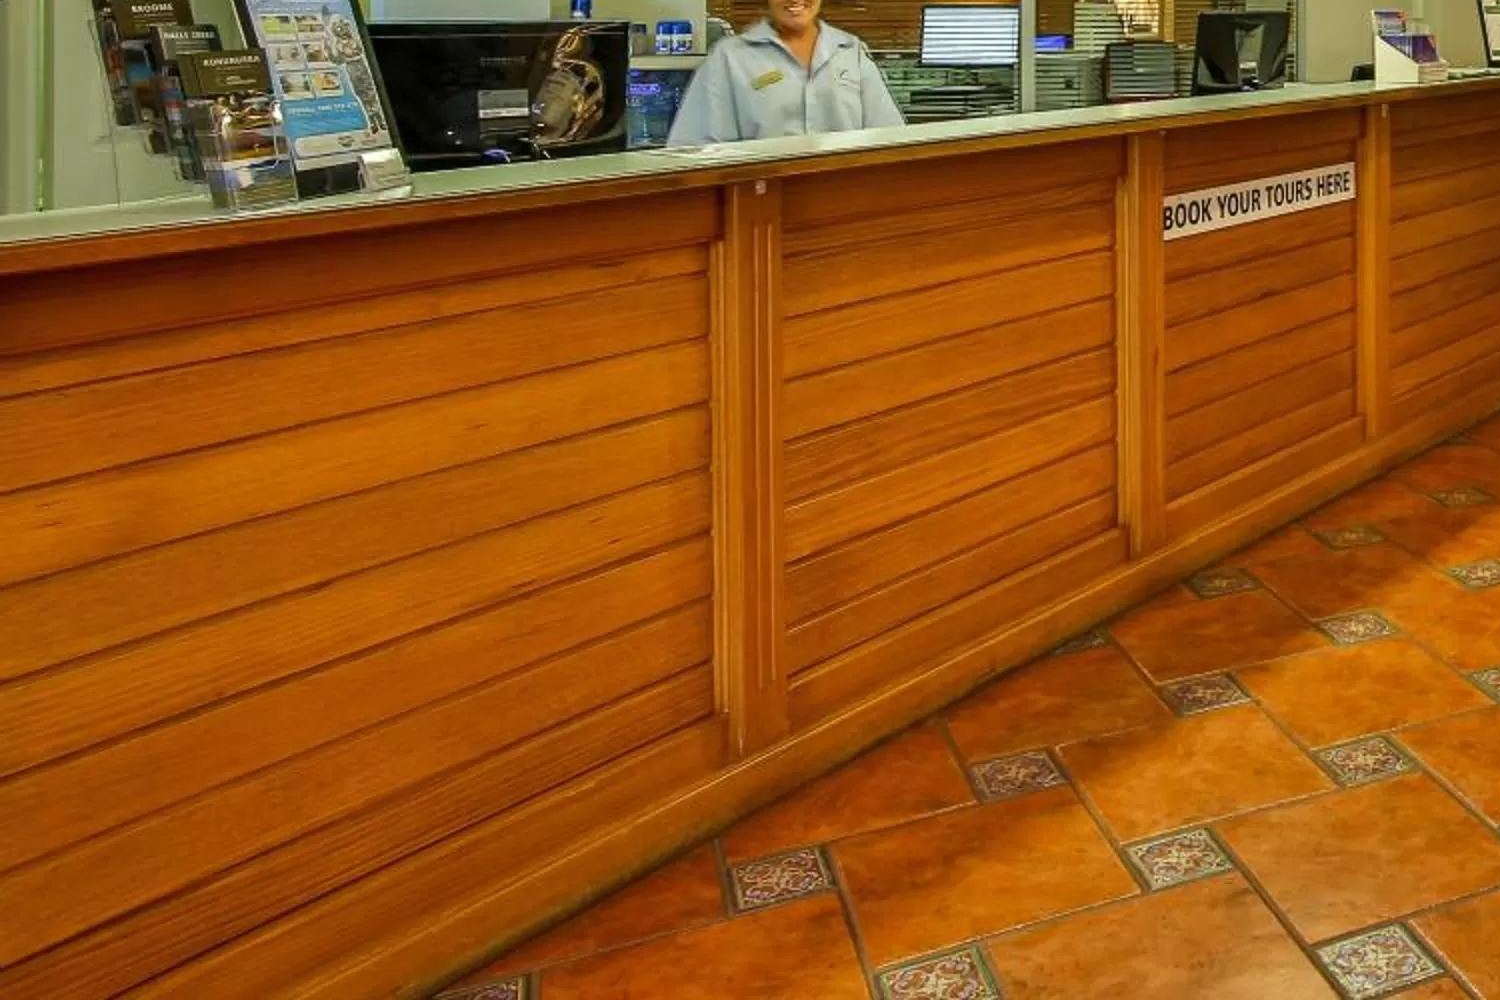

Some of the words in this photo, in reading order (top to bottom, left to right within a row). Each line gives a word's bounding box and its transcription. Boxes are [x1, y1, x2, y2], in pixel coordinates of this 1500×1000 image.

[131, 3, 174, 14] BROOME
[1163, 197, 1212, 231] BOOK
[1217, 189, 1261, 219] YOUR
[1265, 178, 1313, 209] TOURS
[1317, 171, 1351, 197] HERE
